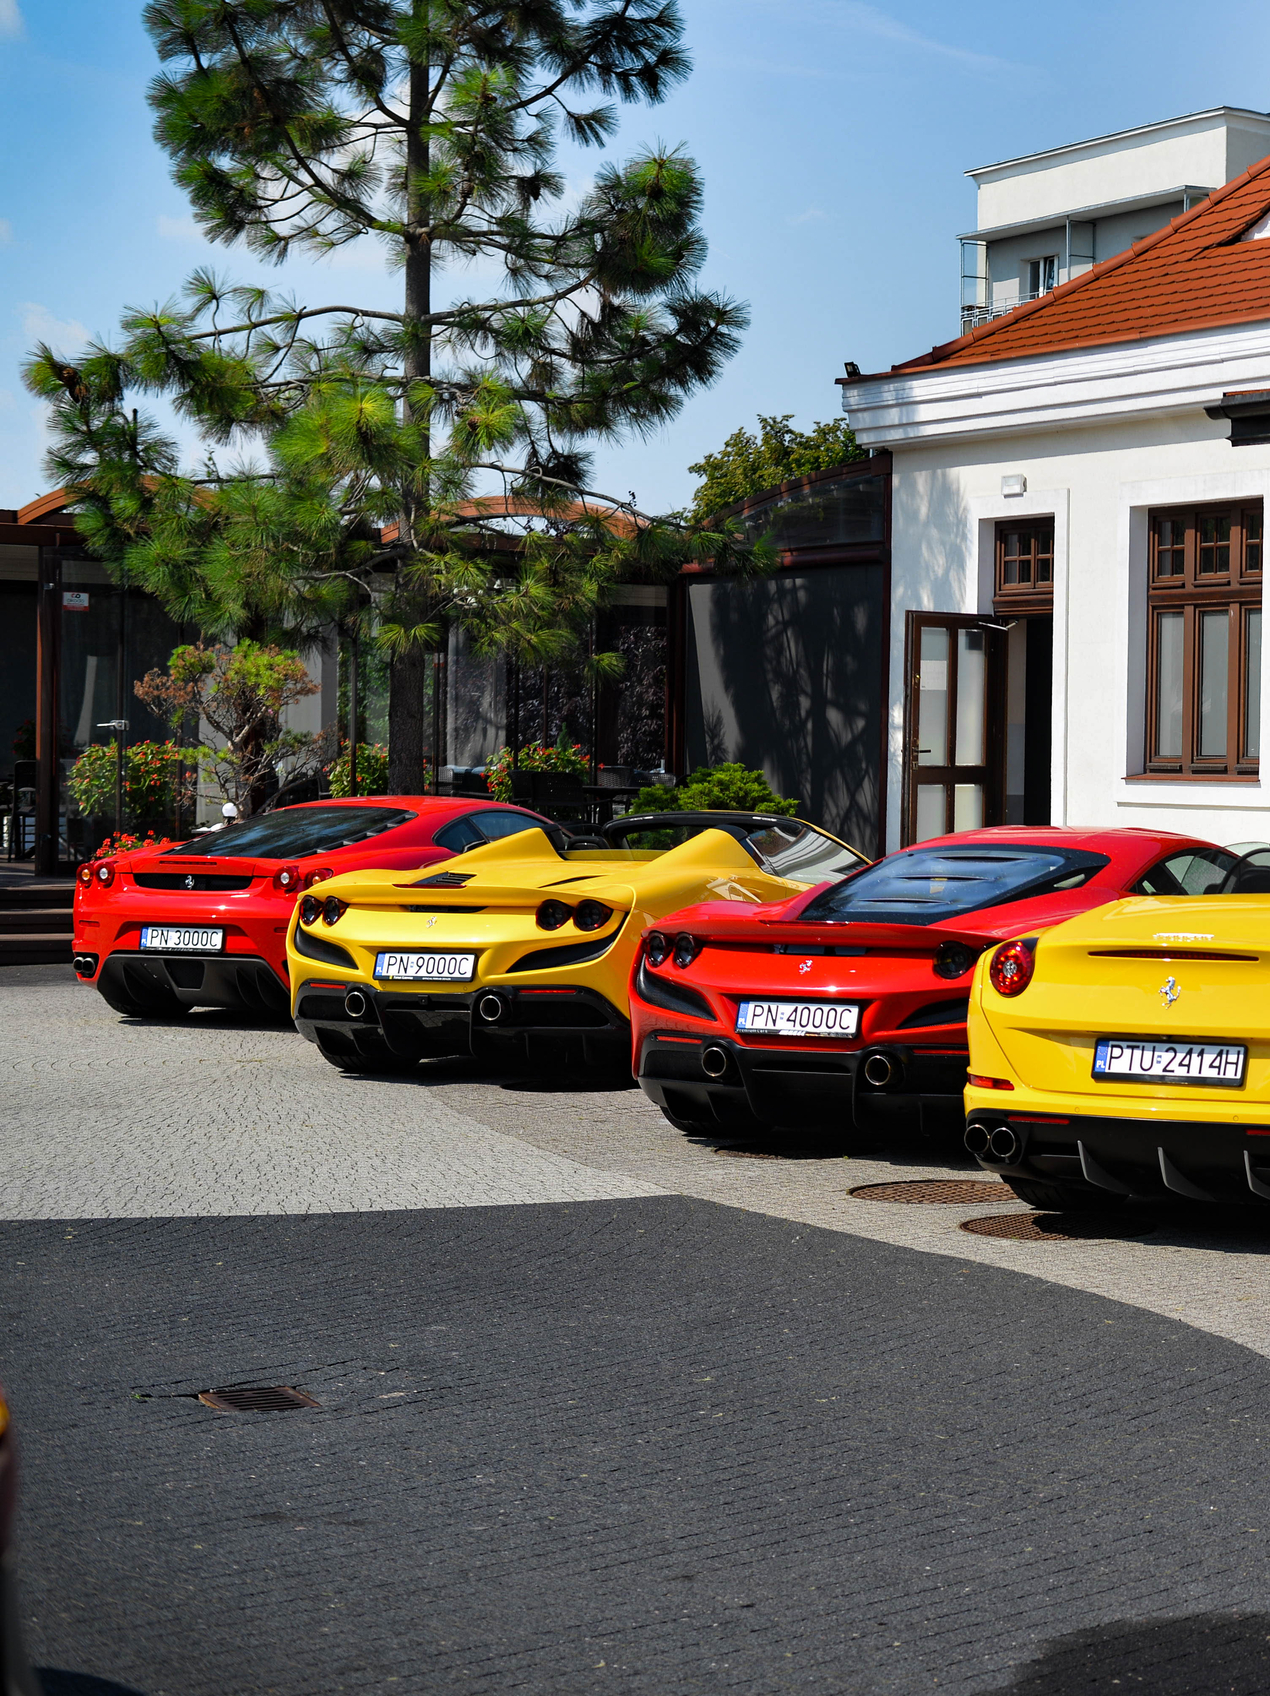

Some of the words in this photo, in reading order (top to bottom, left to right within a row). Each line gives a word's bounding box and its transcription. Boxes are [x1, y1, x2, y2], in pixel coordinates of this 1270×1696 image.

[150, 929, 170, 946] PN
[173, 930, 219, 948] 3000C
[386, 955, 410, 975] PN
[414, 956, 469, 976] 9000C
[750, 1004, 780, 1027] PN
[785, 1006, 852, 1030] 4000C
[1096, 1060, 1106, 1069] PL
[1108, 1044, 1156, 1072] PTU
[1162, 1046, 1241, 1077] 2414H
